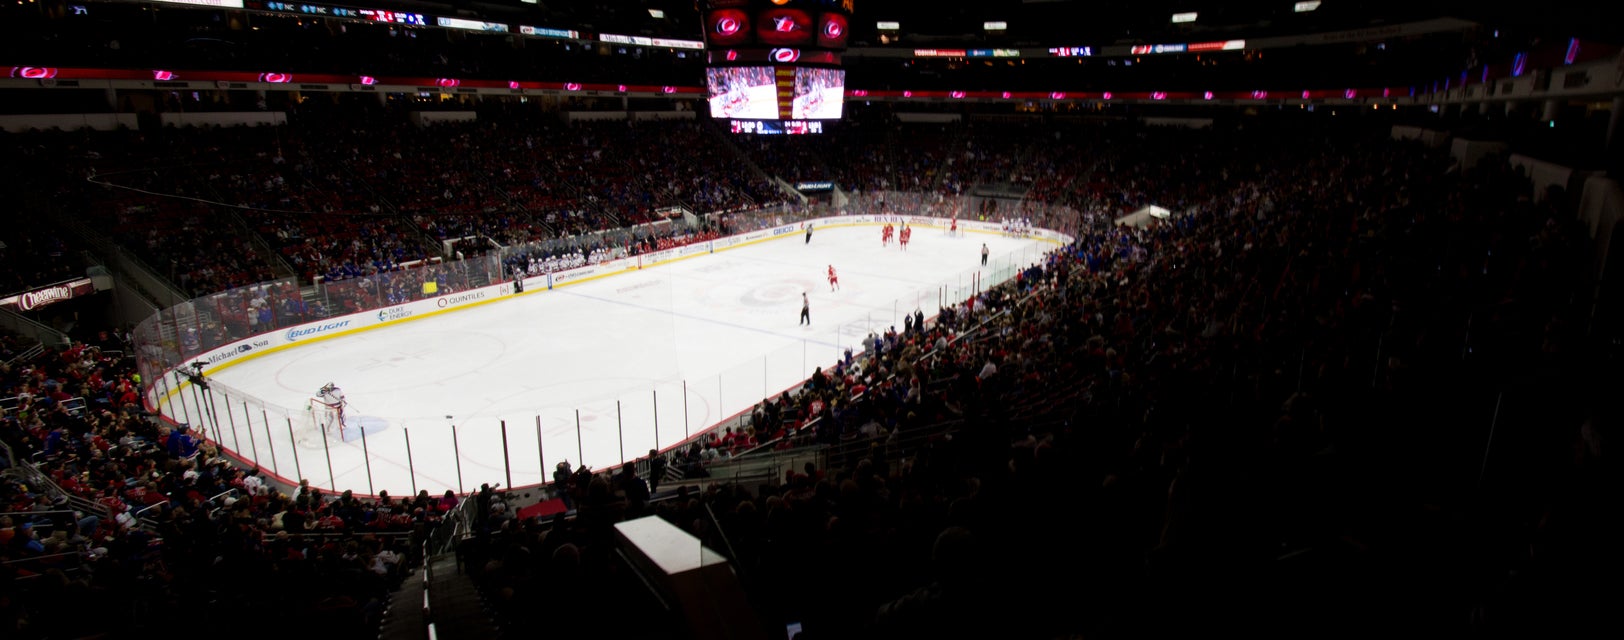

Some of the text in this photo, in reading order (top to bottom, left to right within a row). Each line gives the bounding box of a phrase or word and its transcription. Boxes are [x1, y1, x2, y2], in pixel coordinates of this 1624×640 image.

[284, 3, 295, 11] NC
[317, 7, 327, 15] NC
[914, 49, 937, 57] TOSHIBA
[773, 226, 794, 236] GEICO
[22, 286, 69, 310] Cheerwine
[449, 292, 485, 305] QUINTILES
[389, 306, 404, 315] DUKE
[390, 309, 413, 321] ENERGY
[290, 320, 351, 340] BUD LIGHT
[208, 339, 269, 365] Michael Son
